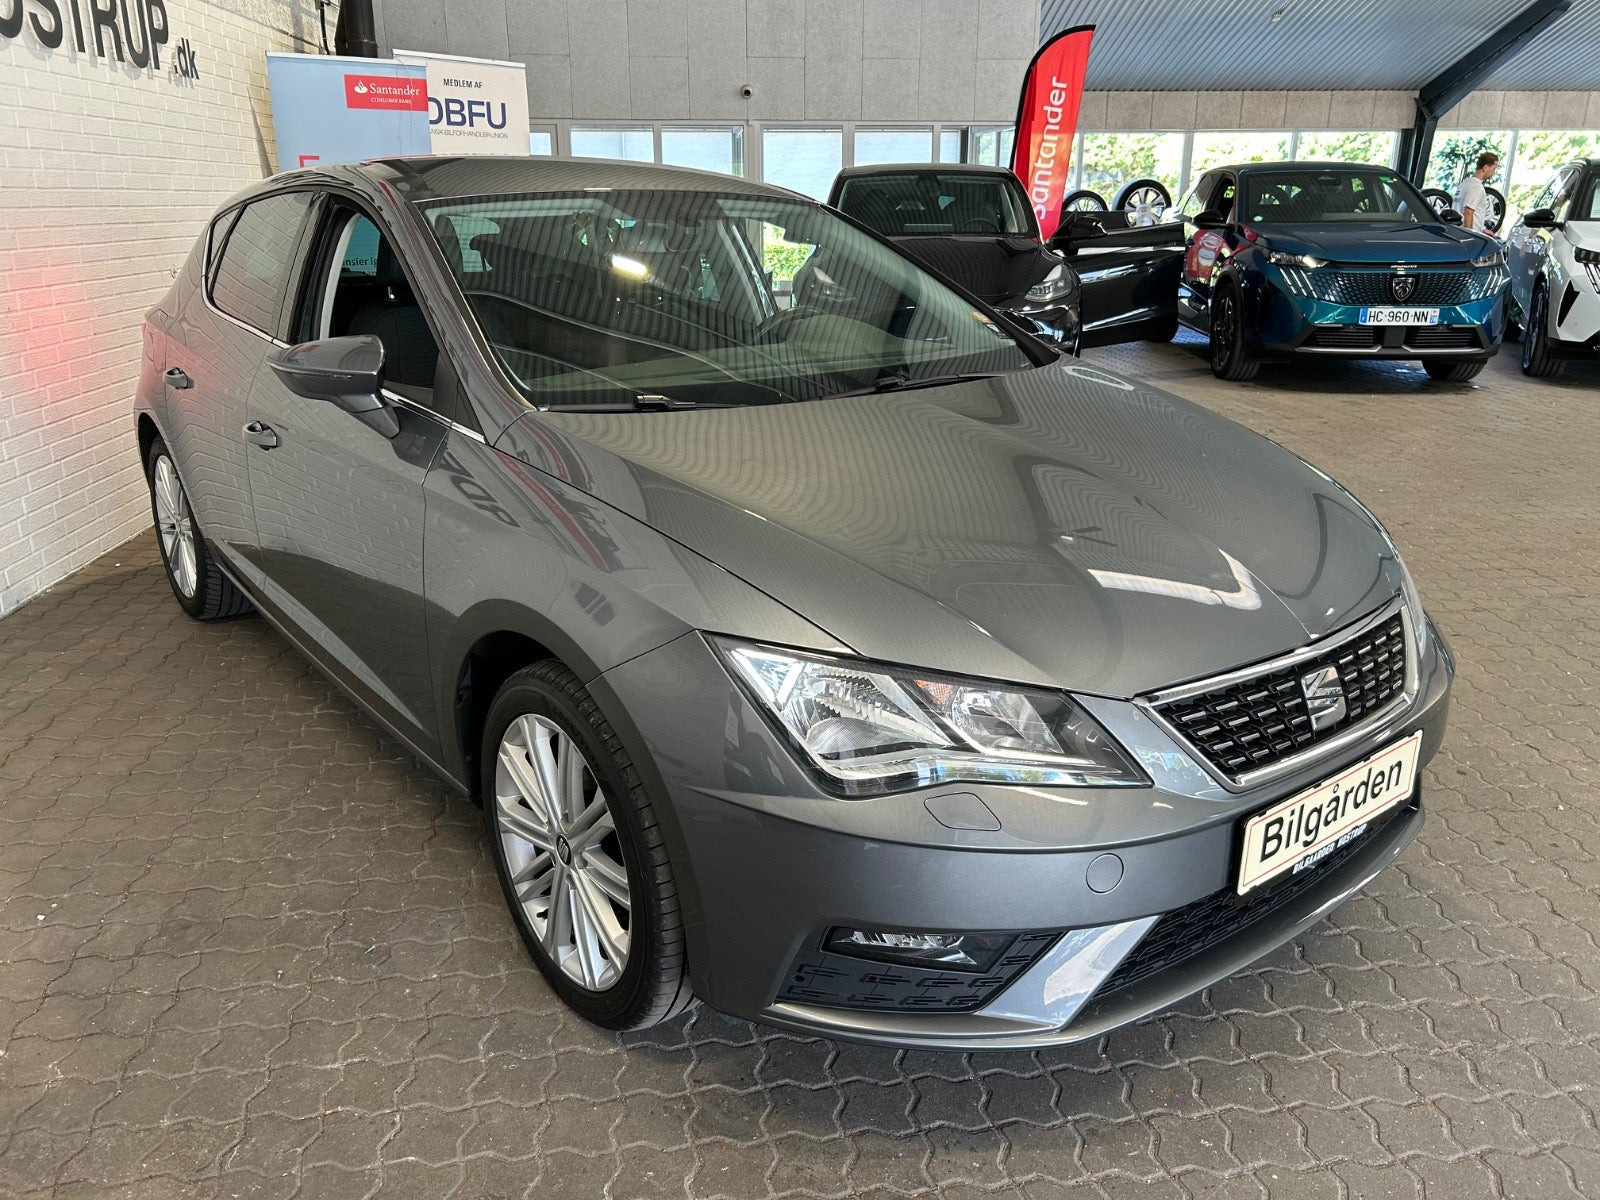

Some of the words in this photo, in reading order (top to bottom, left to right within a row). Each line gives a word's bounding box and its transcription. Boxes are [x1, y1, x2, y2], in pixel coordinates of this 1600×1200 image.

[369, 82, 420, 96] Santander
[443, 78, 472, 88] MEDLEM
[474, 81, 483, 89] AF
[1260, 759, 1403, 863] Bilgården
